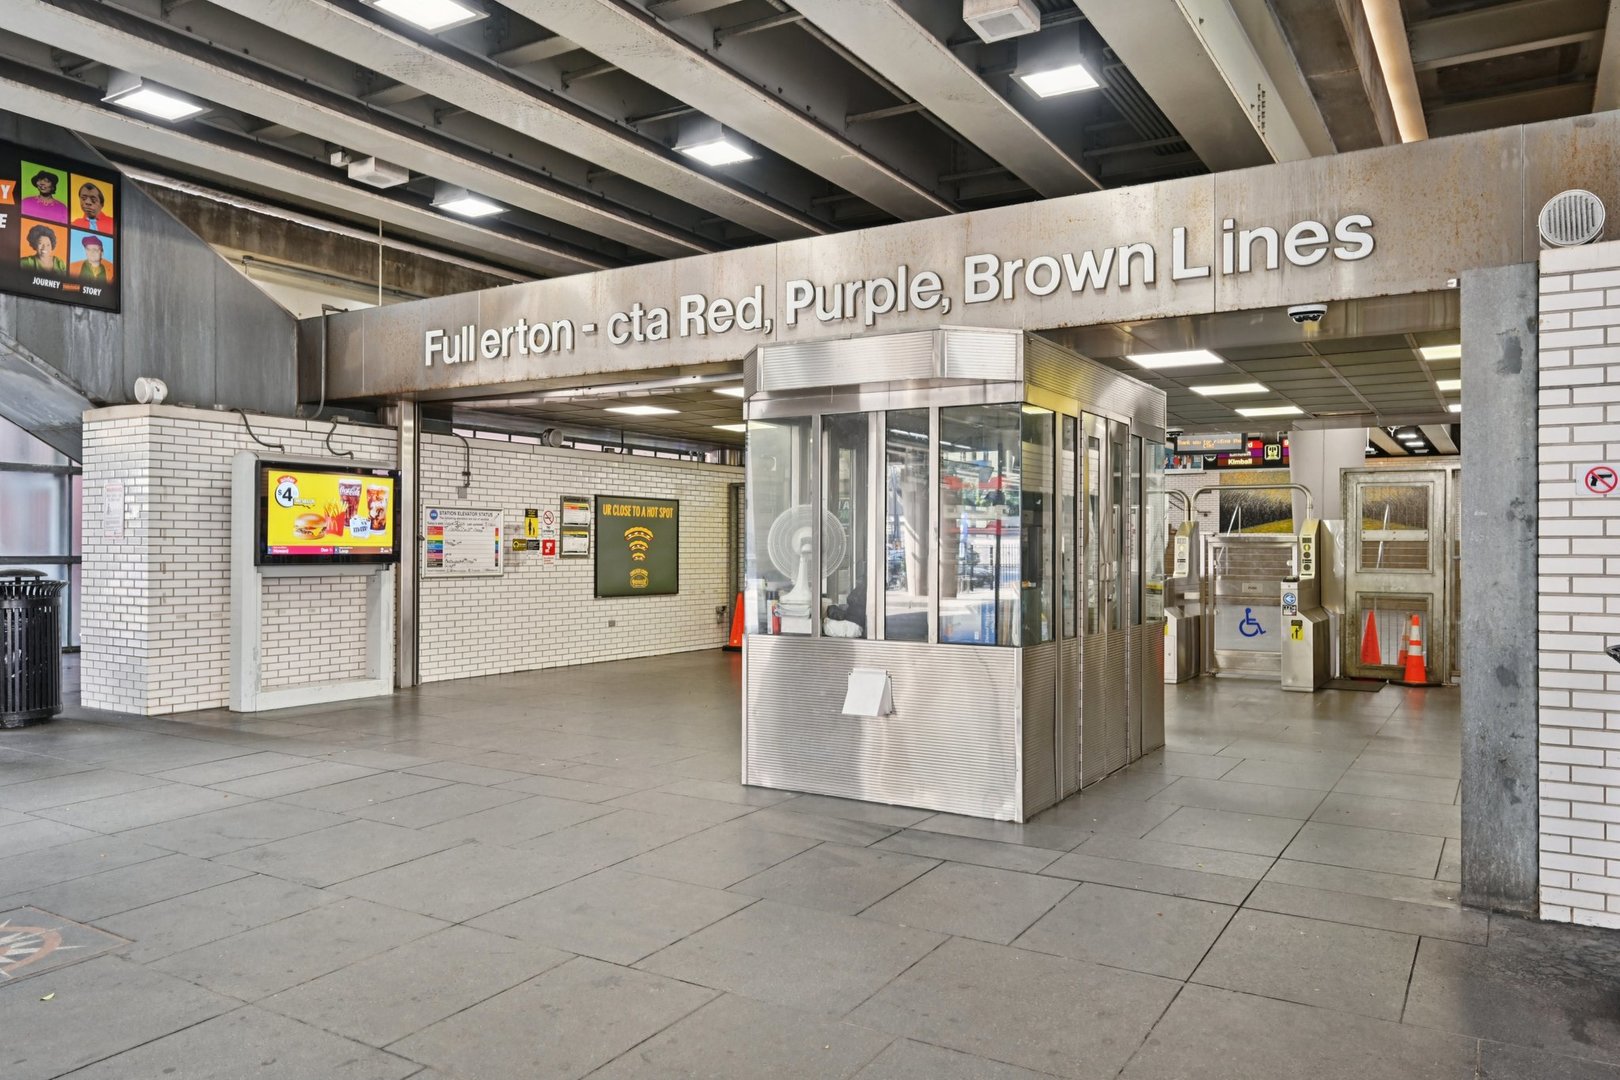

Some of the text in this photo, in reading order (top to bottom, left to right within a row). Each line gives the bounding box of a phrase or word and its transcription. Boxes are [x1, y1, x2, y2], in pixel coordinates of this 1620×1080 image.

[33, 276, 61, 289] JOURNEY
[83, 286, 102, 297] STORY
[424, 318, 575, 367] Fullerton
[607, 302, 670, 346] cta
[679, 285, 774, 336] Red,
[786, 265, 952, 327] Purple,
[964, 240, 1156, 304] Brown
[1172, 213, 1375, 282] Lines
[602, 503, 612, 516] UR
[612, 504, 632, 517] CLOSE
[632, 505, 641, 517] TO
[640, 506, 646, 517] A
[646, 506, 659, 518] HOT
[659, 507, 674, 519] SPOT
